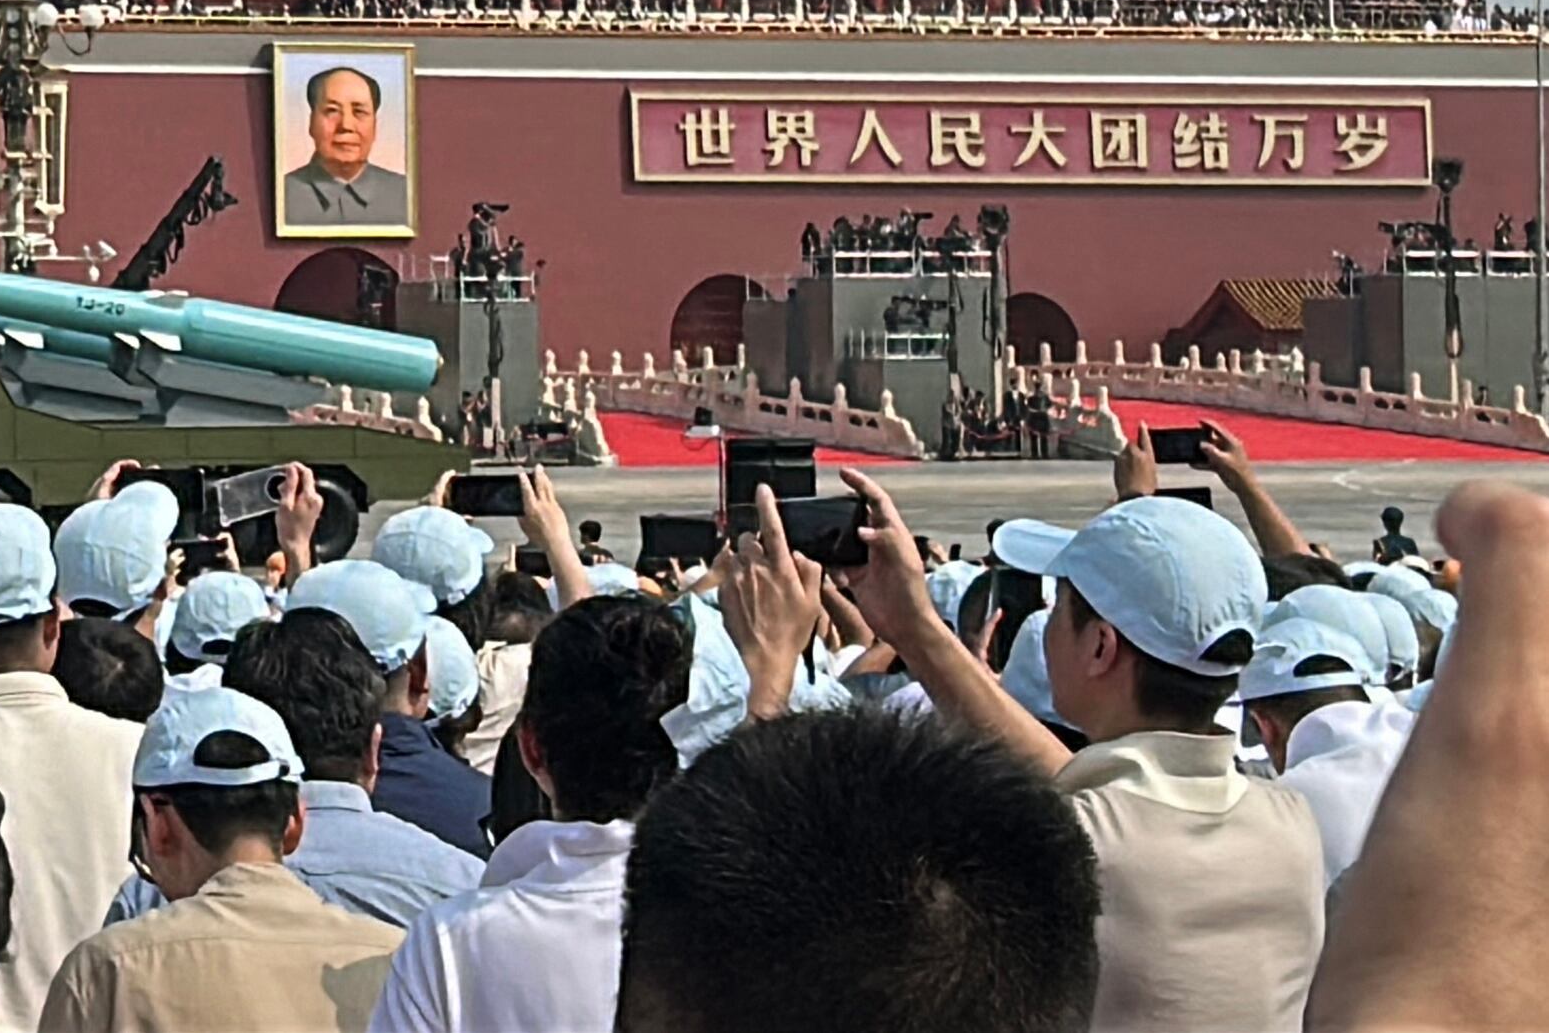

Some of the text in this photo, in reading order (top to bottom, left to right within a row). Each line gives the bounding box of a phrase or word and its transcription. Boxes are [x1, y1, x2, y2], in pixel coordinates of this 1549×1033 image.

[678, 108, 1389, 171] 世界人民大团结万岁
